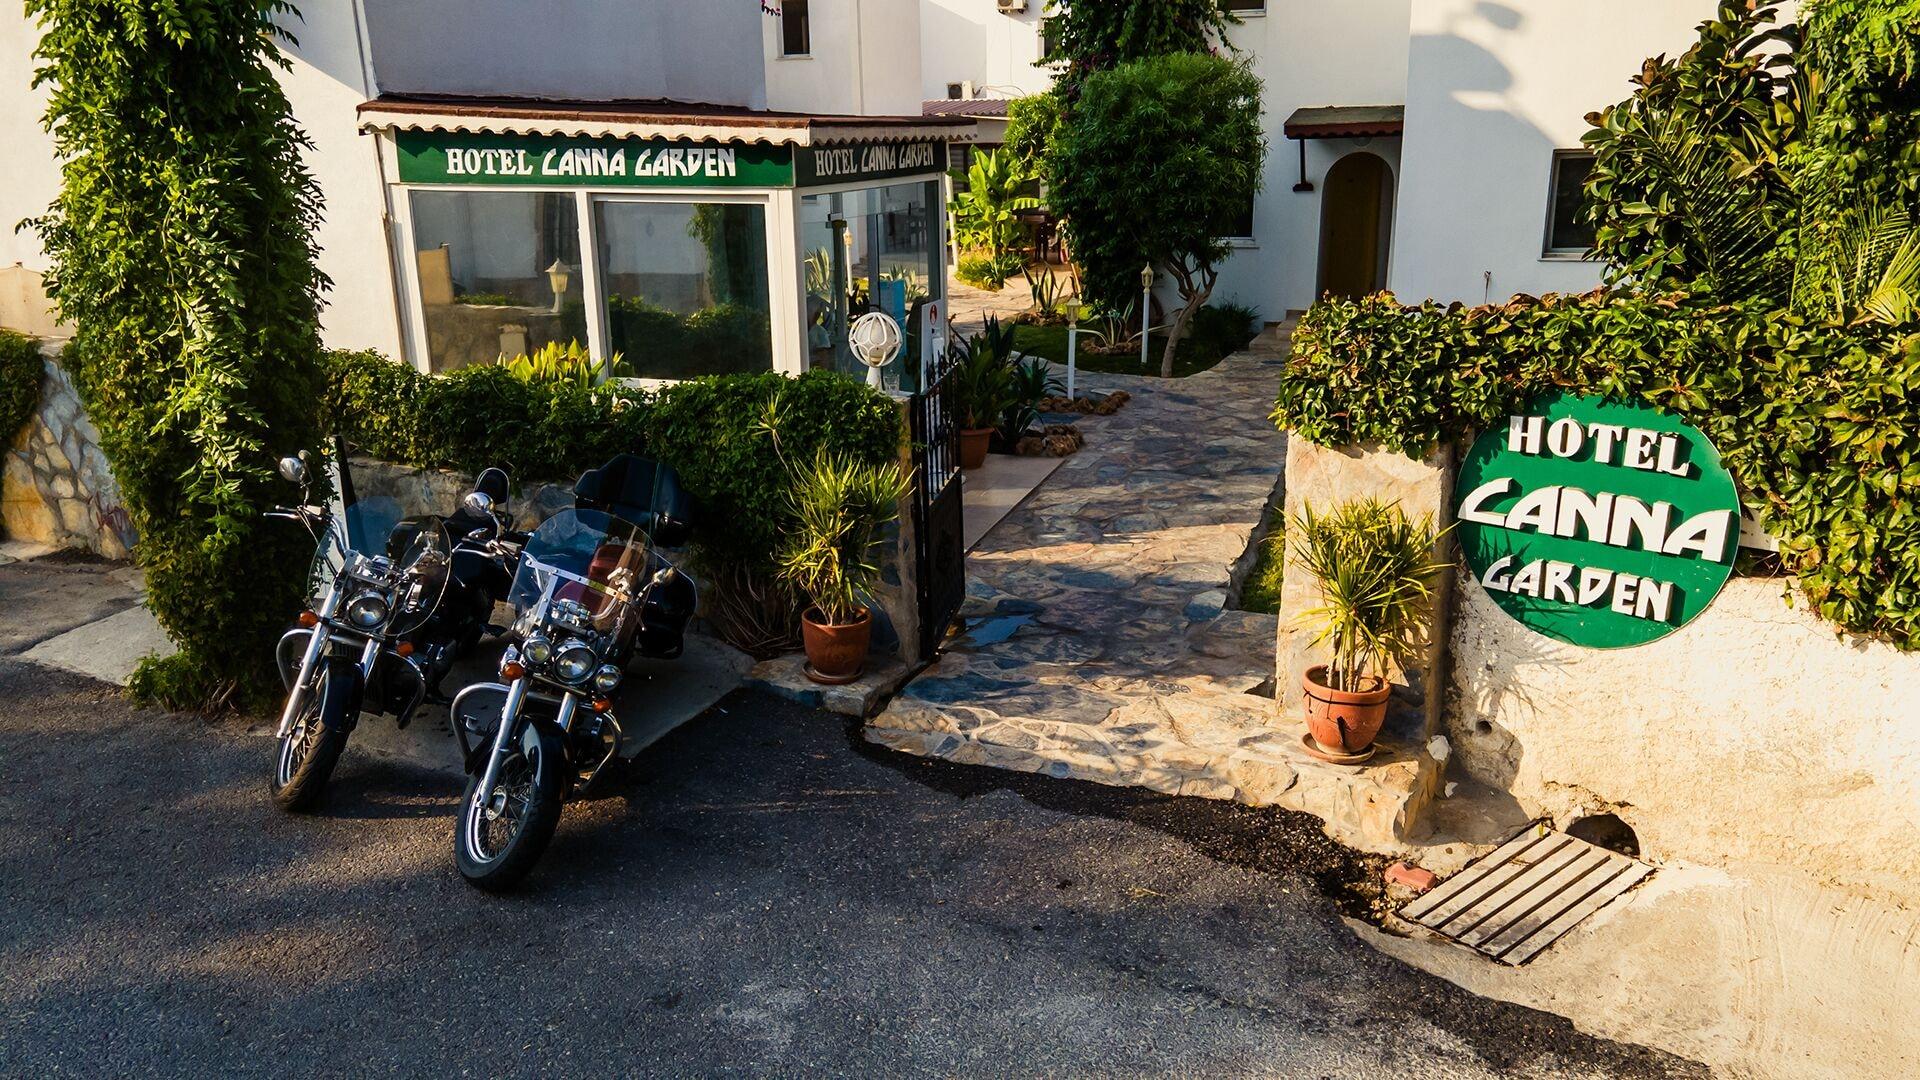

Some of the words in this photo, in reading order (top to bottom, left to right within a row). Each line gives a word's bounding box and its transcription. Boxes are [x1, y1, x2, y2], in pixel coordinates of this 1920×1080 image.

[445, 148, 533, 176] HOTEL
[541, 148, 626, 177] CANNA
[635, 148, 736, 177] GARDEN
[815, 149, 858, 177] HOTEL
[861, 145, 896, 173] CANNA
[899, 143, 934, 169] GARDEN
[1507, 415, 1690, 477] HOTEL
[1457, 477, 1733, 563] CANNA
[1481, 554, 1674, 622] GARDEN
